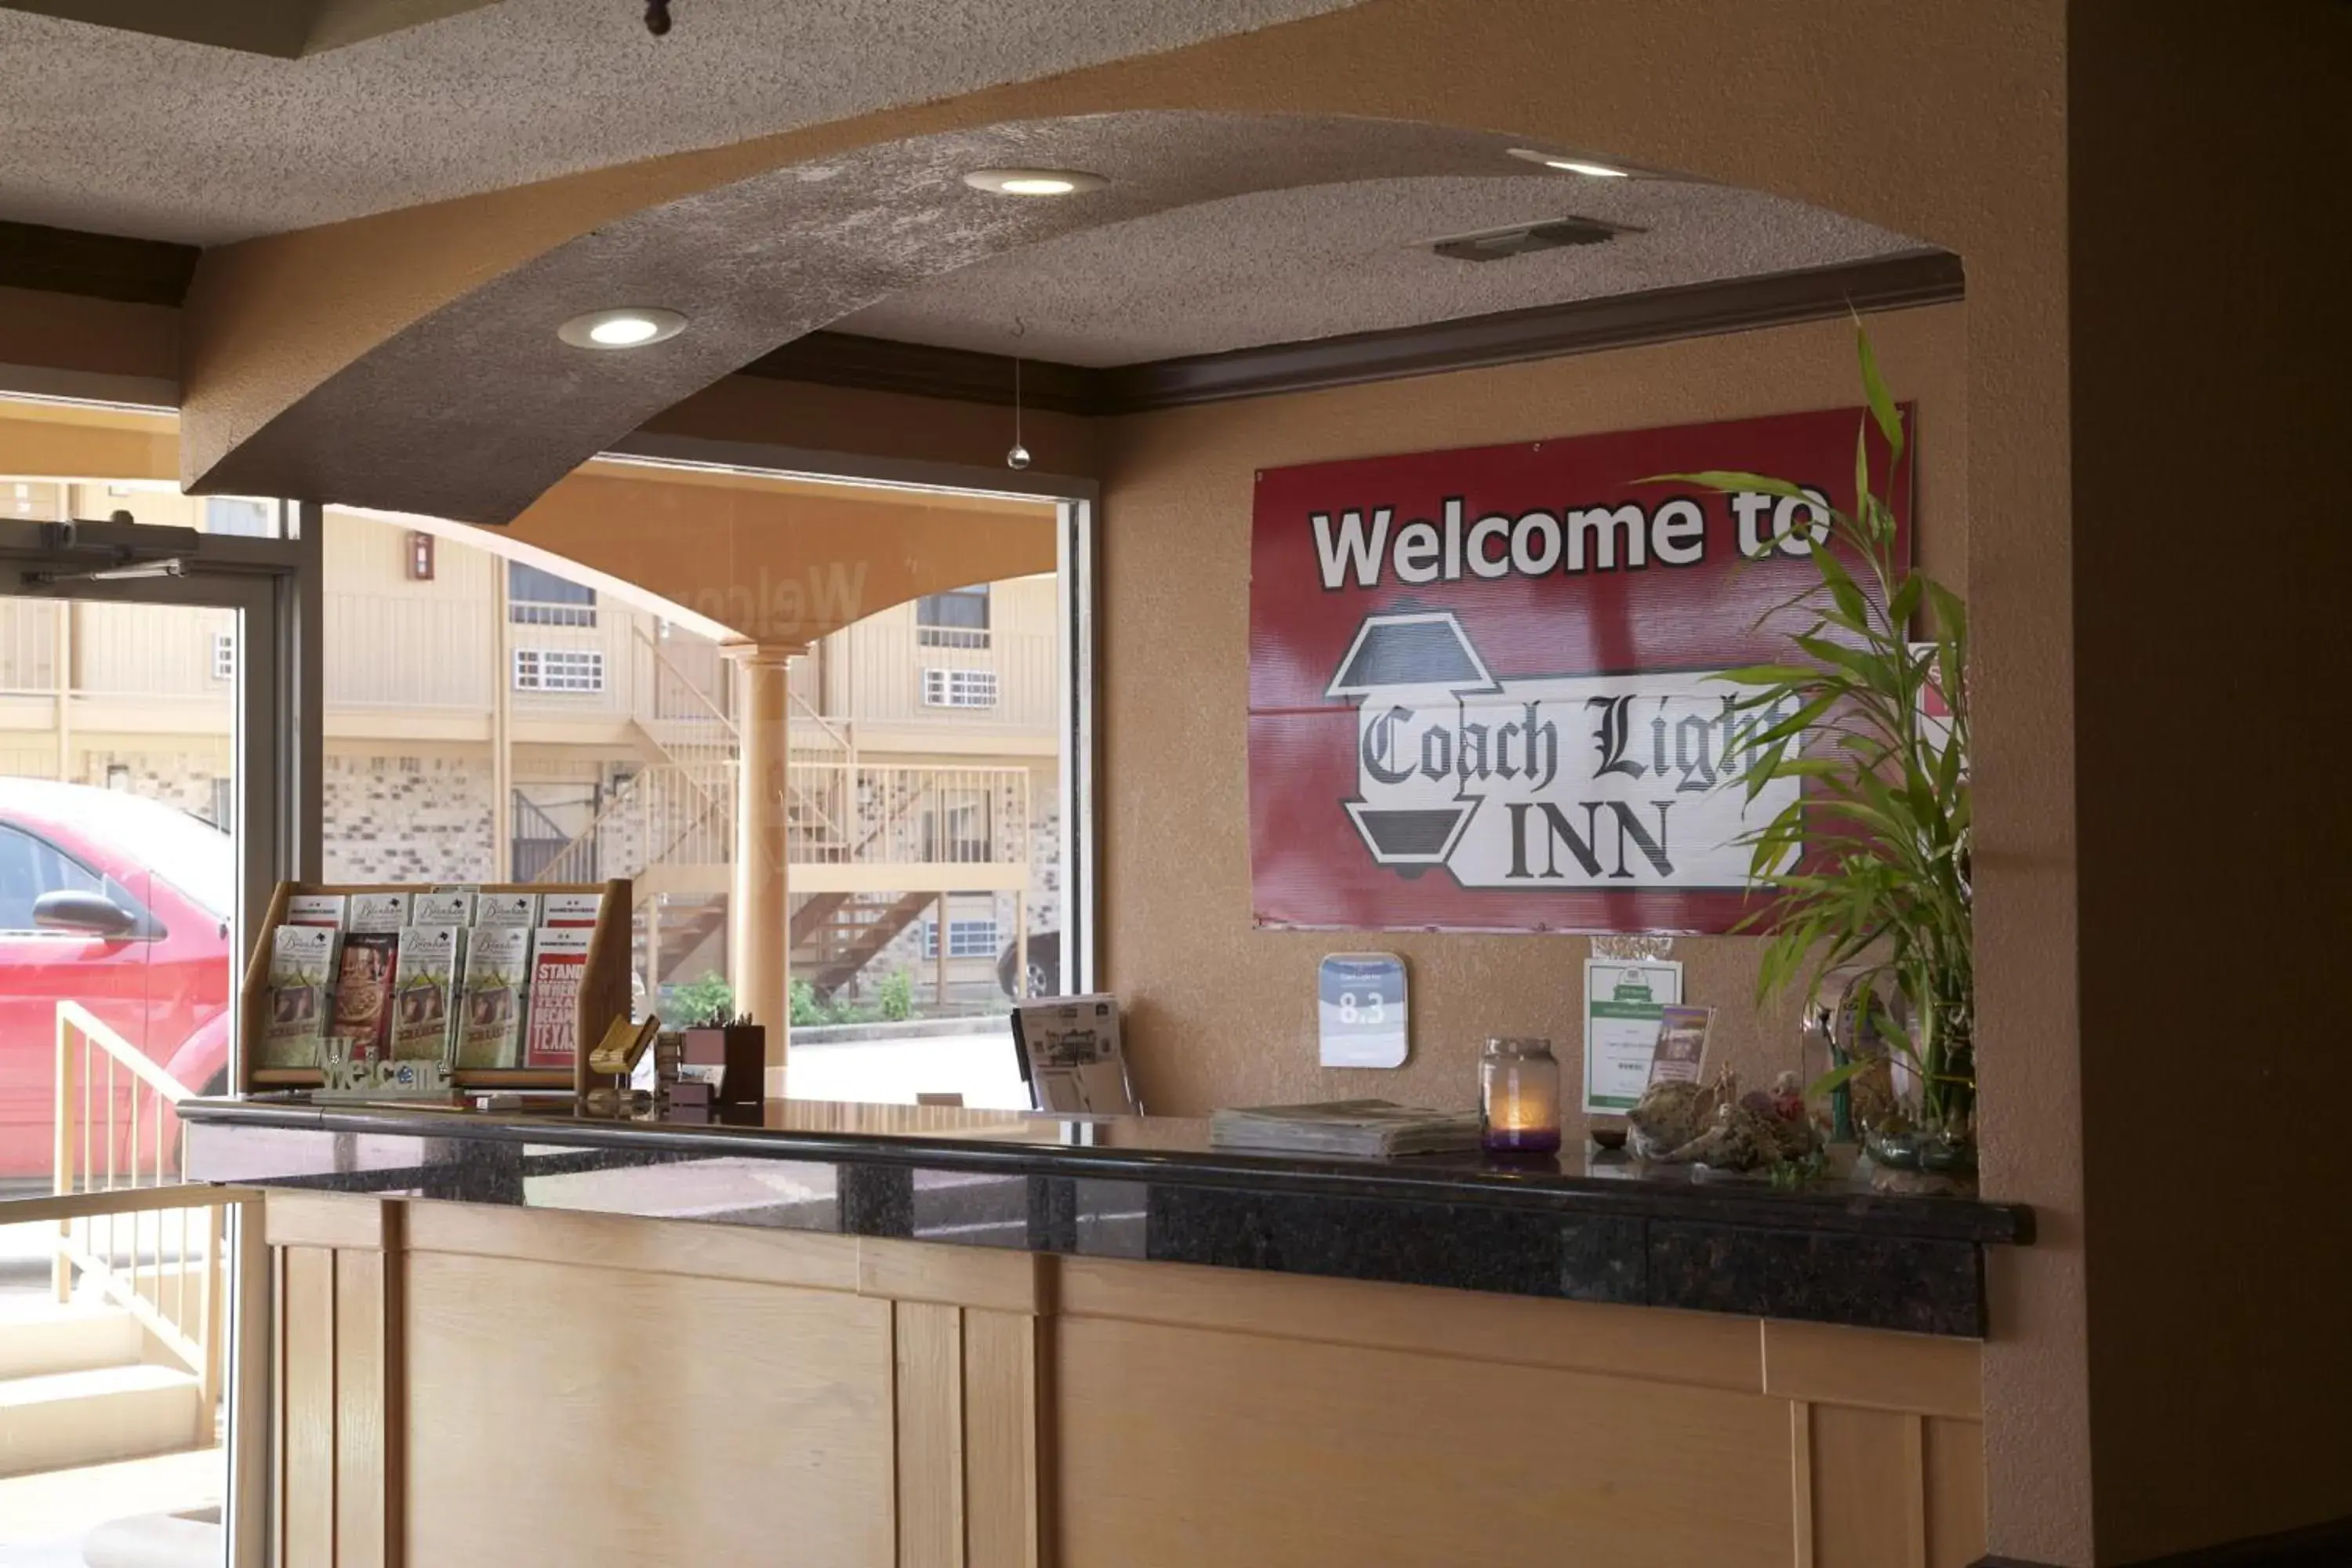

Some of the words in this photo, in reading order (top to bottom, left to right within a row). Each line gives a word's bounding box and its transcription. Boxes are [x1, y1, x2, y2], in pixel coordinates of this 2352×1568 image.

[1309, 497, 1705, 590] Welcome
[1730, 487, 1833, 559] to
[1362, 700, 1559, 793] Coach
[1504, 800, 1677, 879] INN
[1339, 992, 1385, 1024] 8.3
